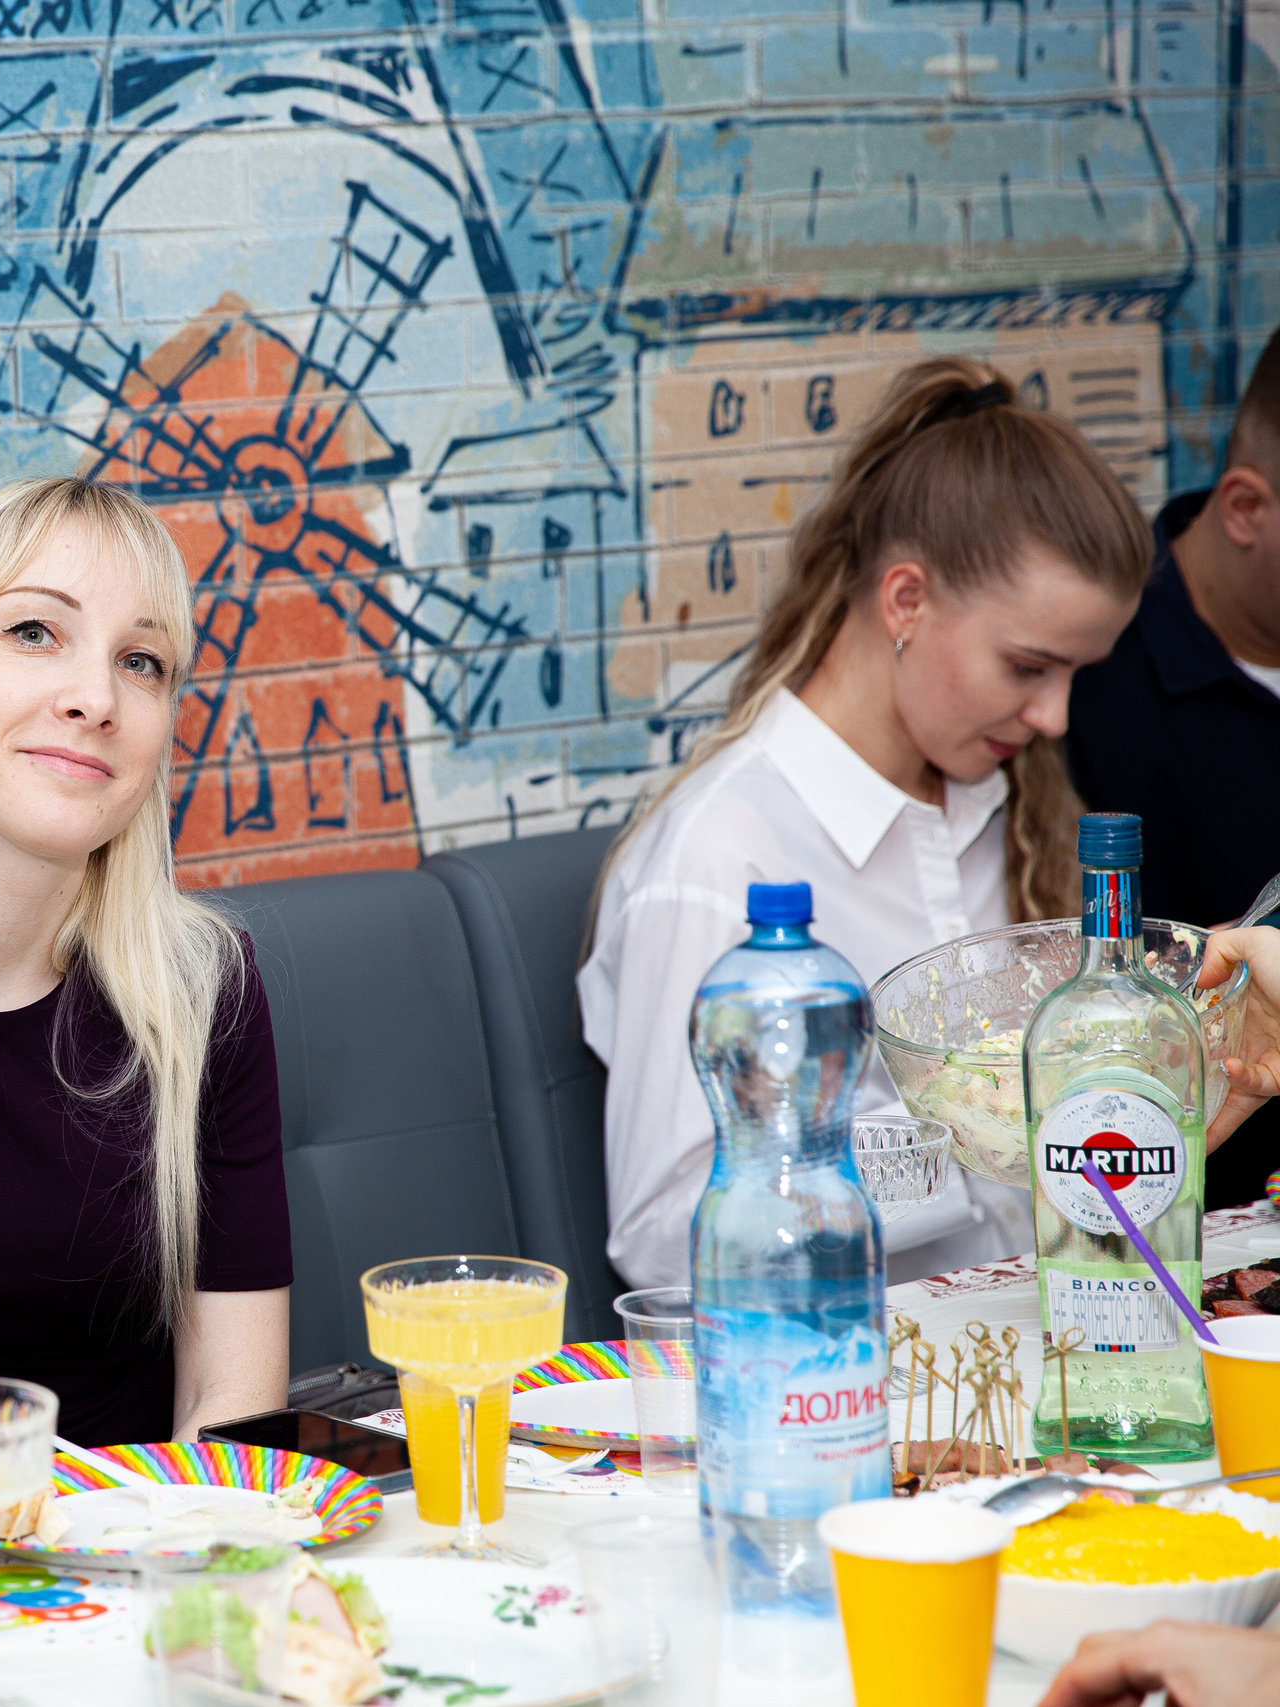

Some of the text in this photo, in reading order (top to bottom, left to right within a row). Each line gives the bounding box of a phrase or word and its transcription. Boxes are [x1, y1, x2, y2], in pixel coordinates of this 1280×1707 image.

[1049, 1147, 1171, 1173] MARTINI
[1070, 1201, 1150, 1222] L'APERIVO
[1072, 1279, 1157, 1292] BIANCO
[1053, 1290, 1179, 1342] НЕ ЯВЛЯЕТСЯ ВИНОМ
[1089, 1401, 1158, 1425] 1863
